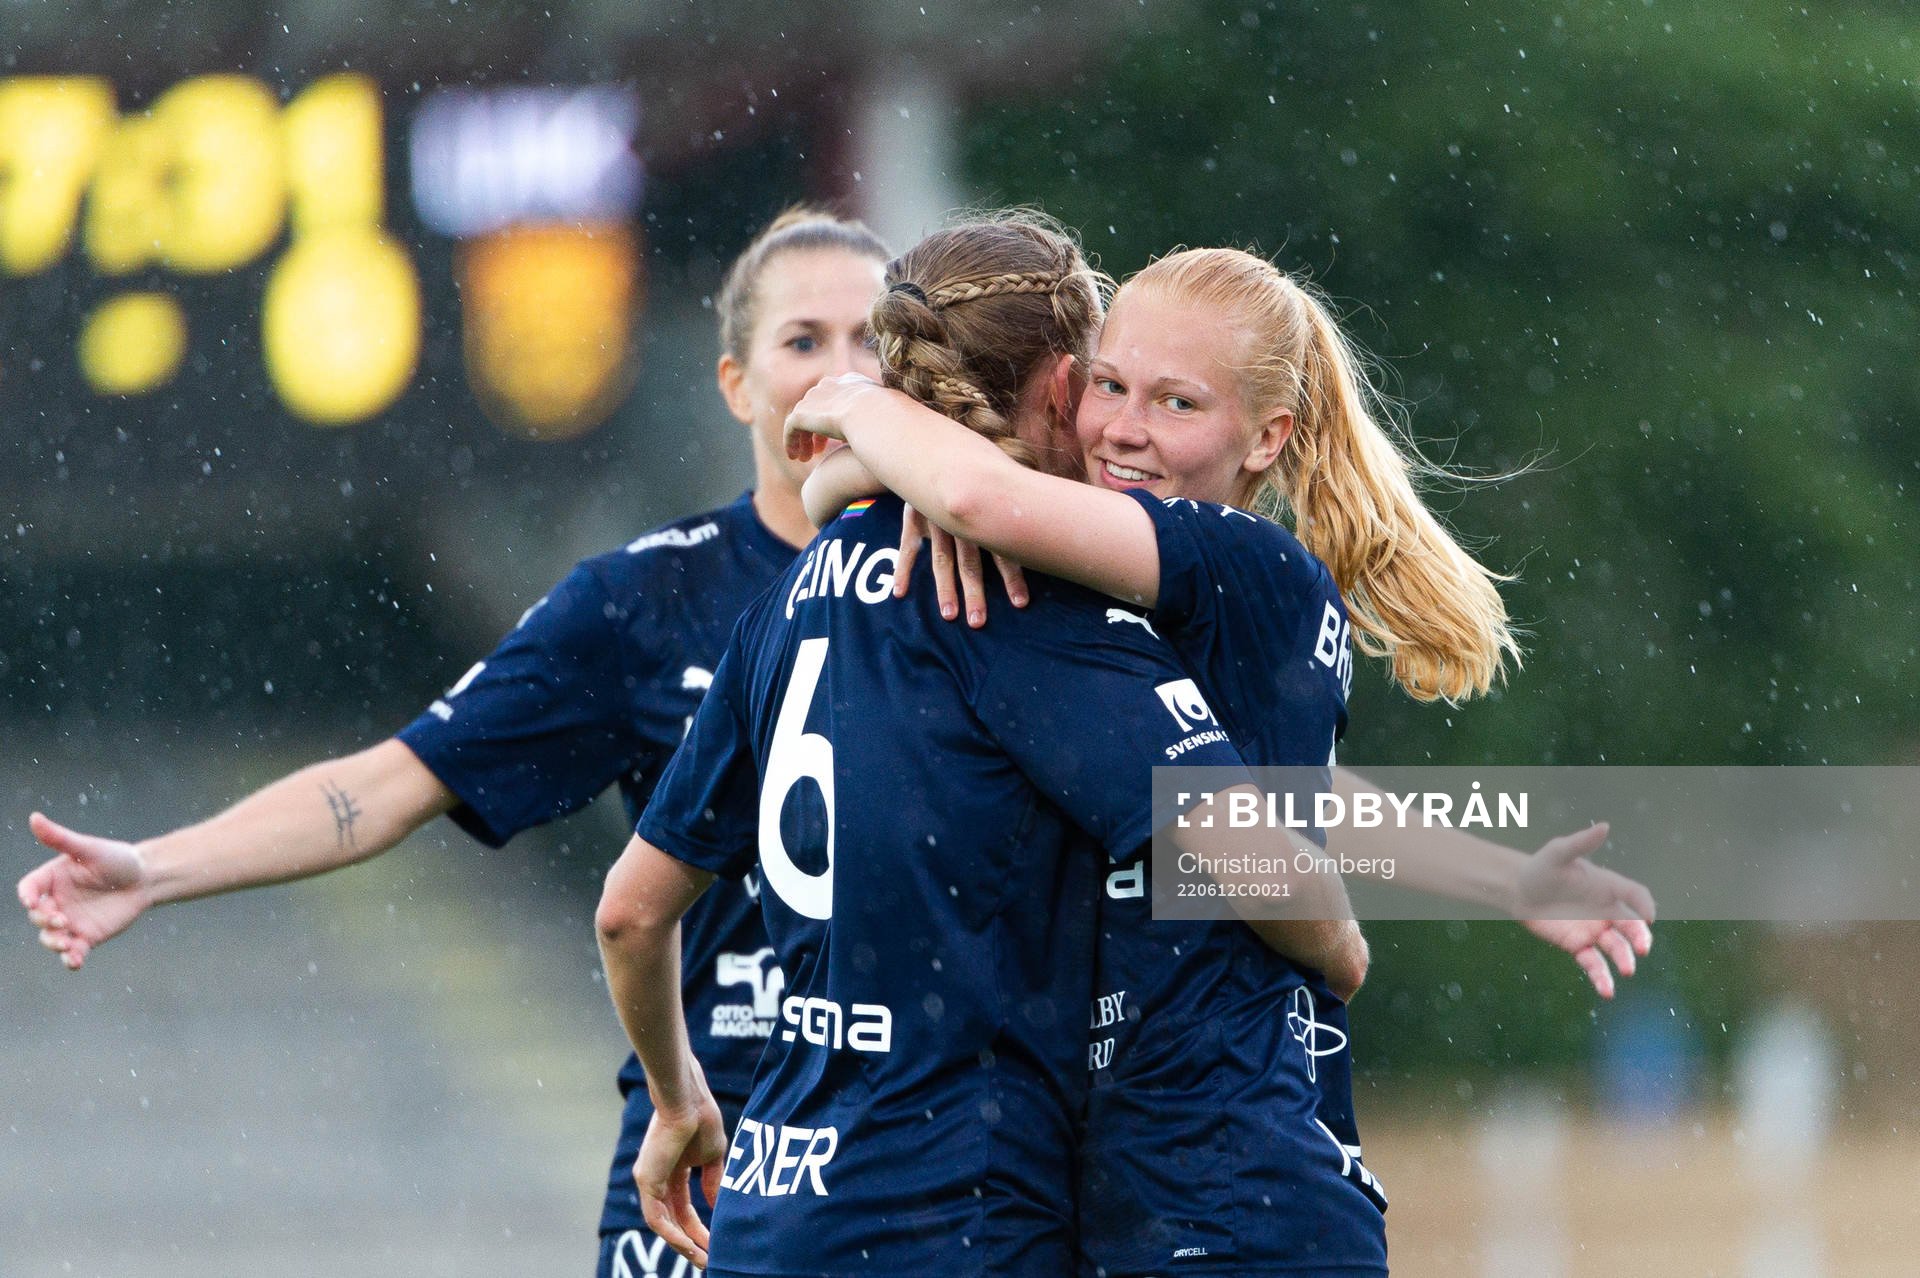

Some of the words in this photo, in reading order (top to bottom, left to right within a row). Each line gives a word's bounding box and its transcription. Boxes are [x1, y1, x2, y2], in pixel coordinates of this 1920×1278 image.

[757, 638, 834, 920] 6
[710, 1020, 777, 1037] MAGNU
[1173, 1247, 1209, 1258] DRYCELL
